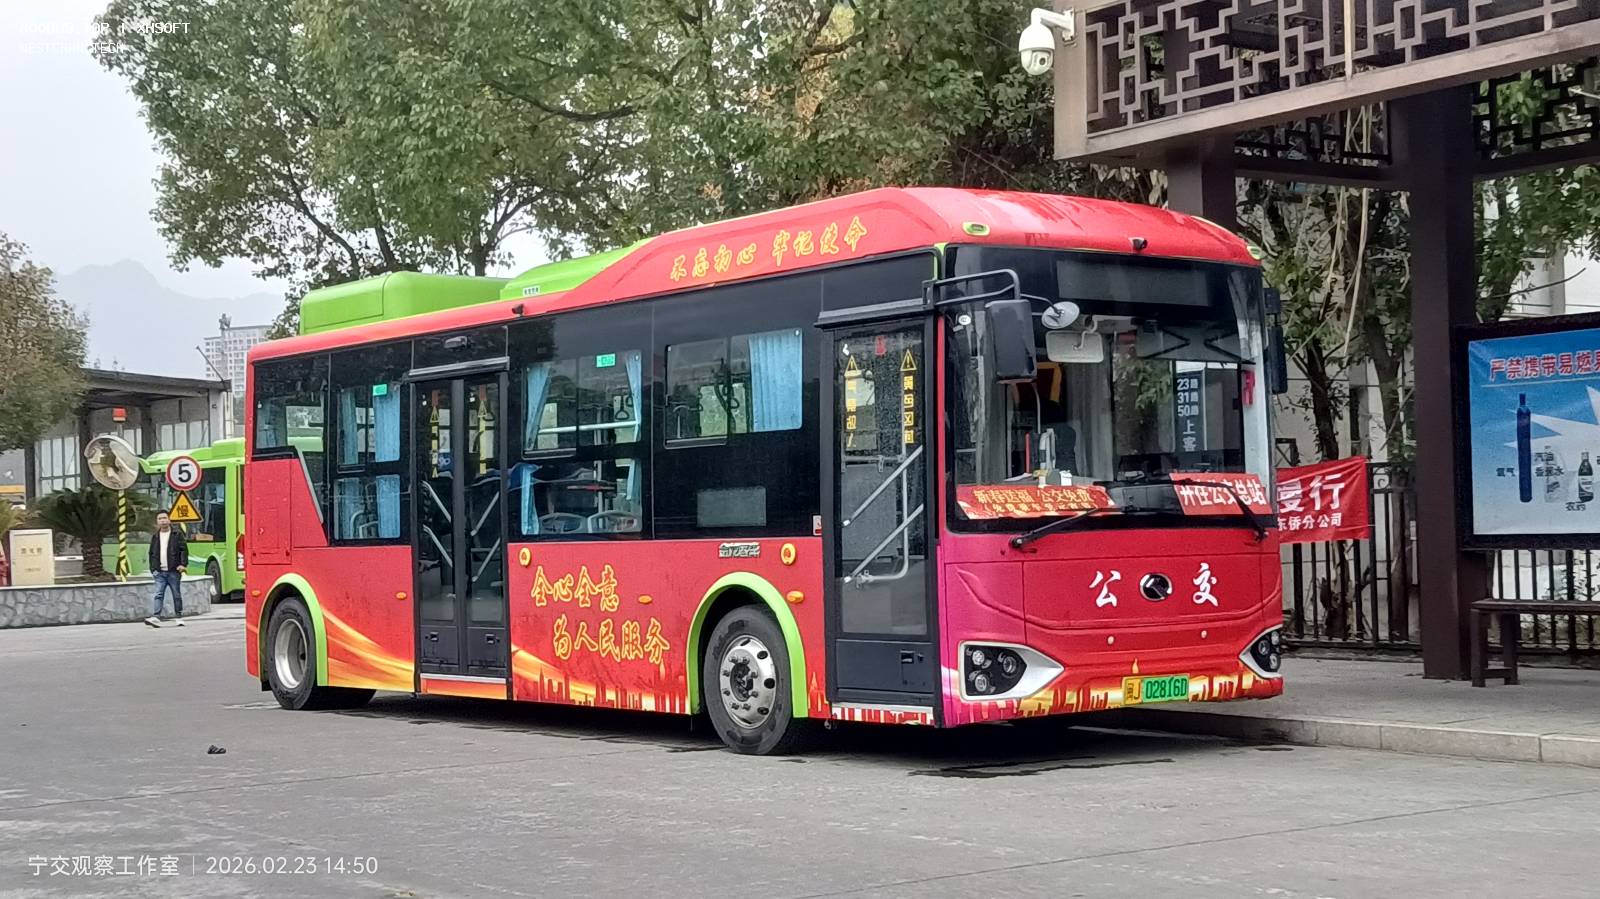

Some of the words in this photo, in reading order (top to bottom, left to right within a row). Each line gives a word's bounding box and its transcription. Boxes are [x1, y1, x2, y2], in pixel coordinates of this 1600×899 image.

[670, 243, 757, 282] 不忘初心
[772, 216, 868, 267] 牢记使命
[178, 463, 192, 483] 5
[176, 504, 190, 518] 慢
[531, 565, 619, 612] 全心全意
[553, 614, 670, 665] 为人民服务
